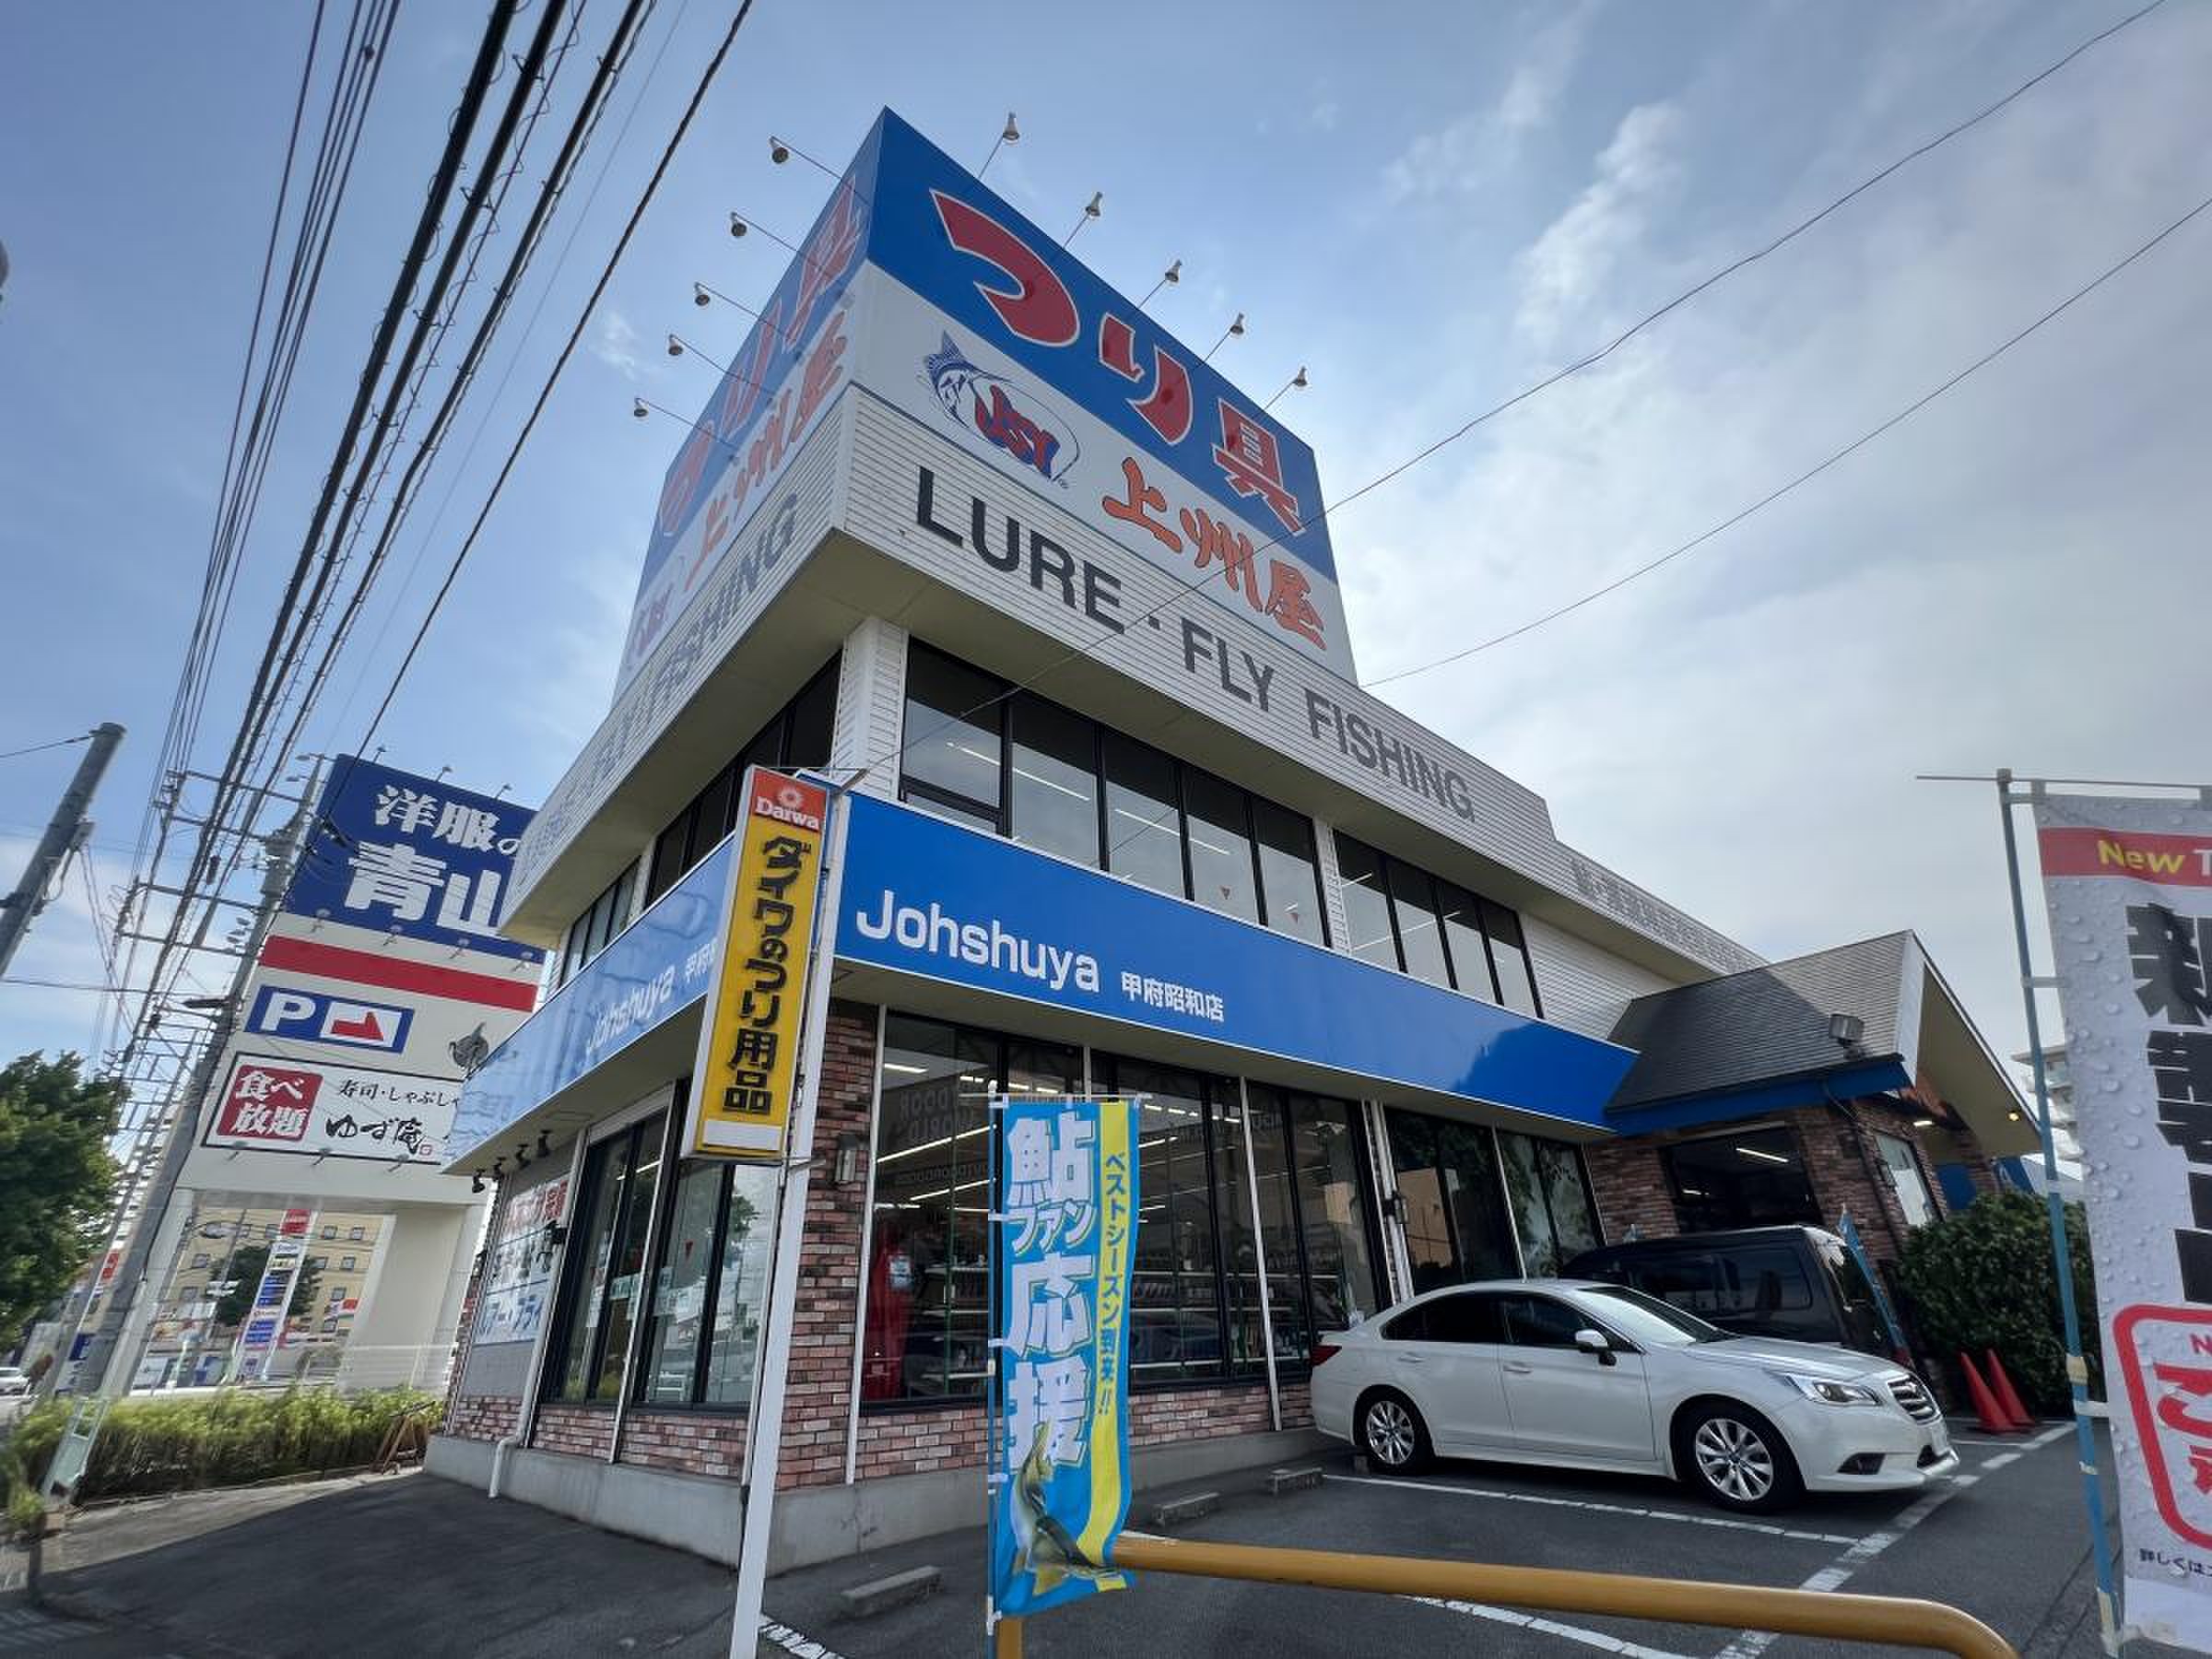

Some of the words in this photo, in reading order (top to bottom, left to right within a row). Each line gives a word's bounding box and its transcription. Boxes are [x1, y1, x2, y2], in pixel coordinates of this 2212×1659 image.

[928, 187, 1305, 536] つり具
[1101, 456, 1328, 652] 上州屋
[915, 465, 1125, 635] LURE
[1181, 616, 1275, 712] FLY
[1303, 688, 1475, 823] FISHING
[755, 795, 823, 832] Daiwa
[2097, 839, 2185, 874] New
[344, 840, 505, 940] 青山
[723, 835, 812, 1114] ダイワのつり用品
[856, 888, 1100, 994] Johshuya
[1120, 971, 1225, 1023] 甲府昭和店
[261, 992, 316, 1031] P
[229, 1101, 309, 1137] 放題
[235, 1070, 305, 1101] 食べ
[325, 1113, 425, 1155] ゆず庵
[1007, 1111, 1094, 1206] 鮎
[1008, 1197, 1095, 1253] ファン
[1008, 1251, 1093, 1474] 応援
